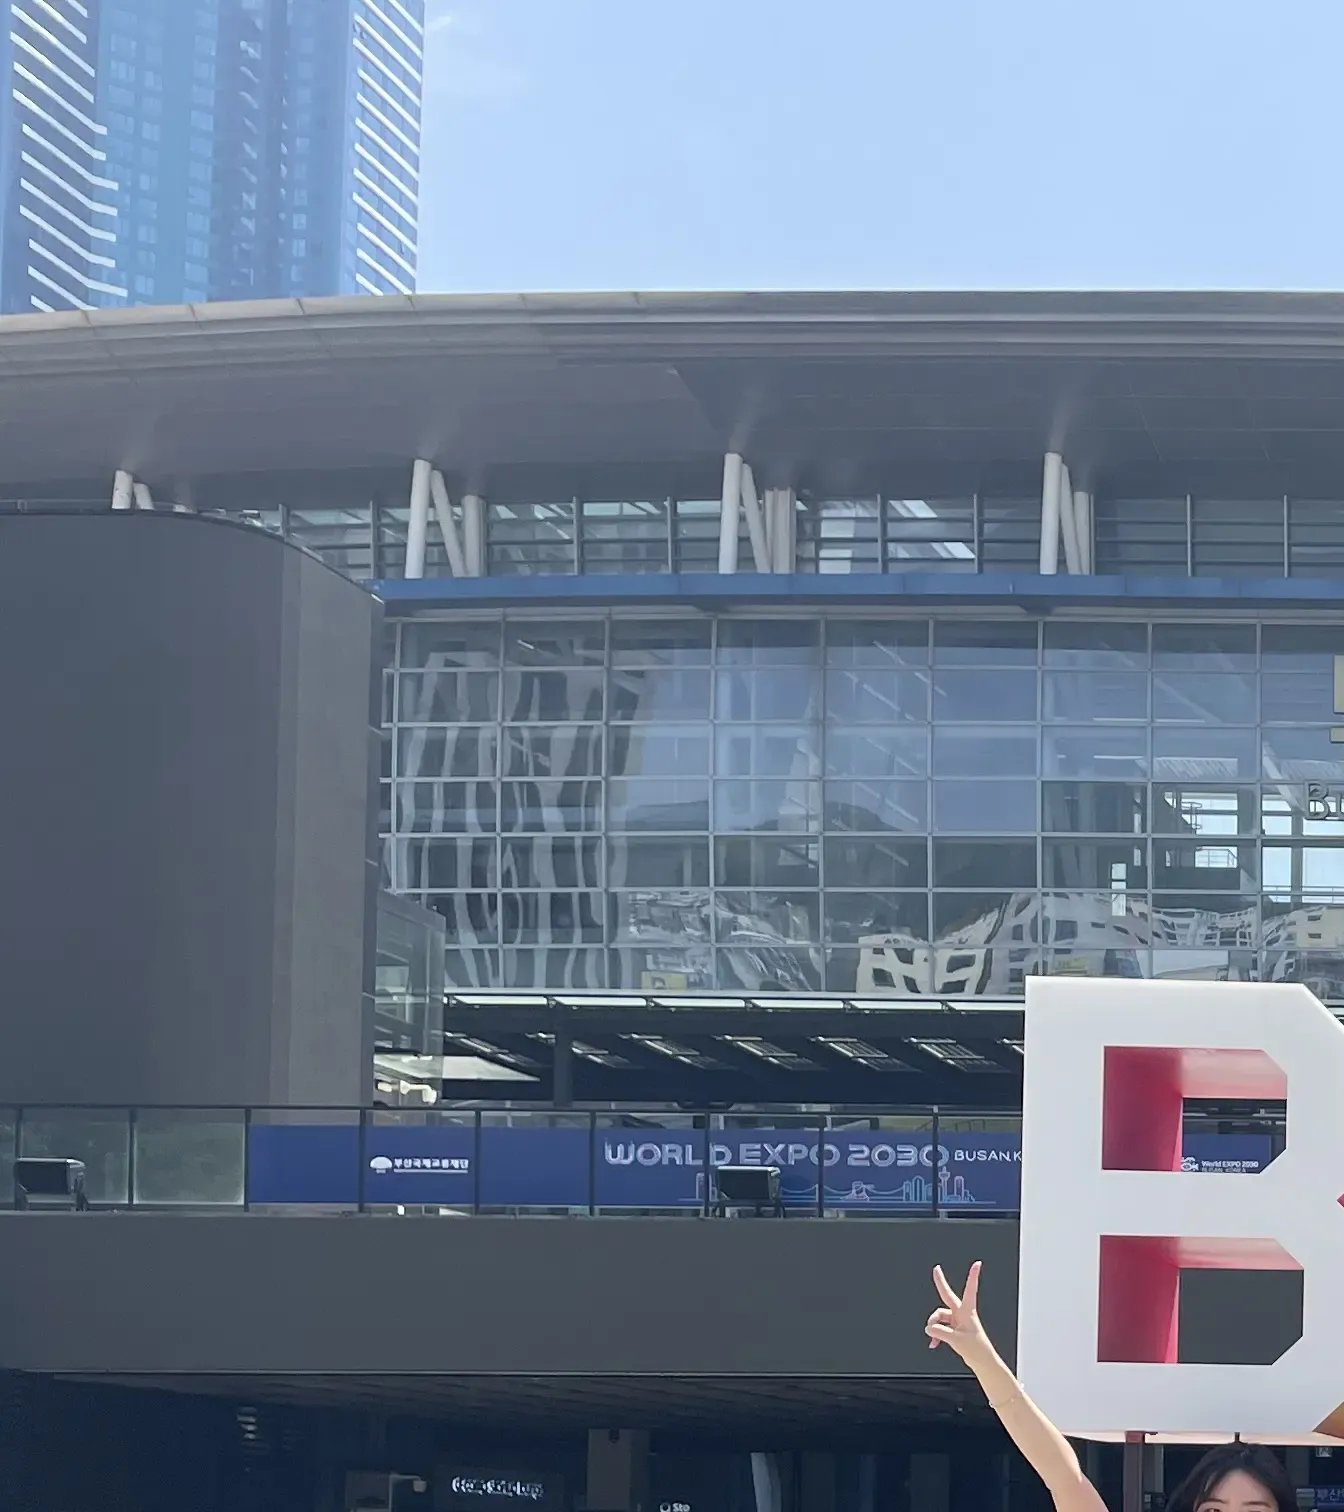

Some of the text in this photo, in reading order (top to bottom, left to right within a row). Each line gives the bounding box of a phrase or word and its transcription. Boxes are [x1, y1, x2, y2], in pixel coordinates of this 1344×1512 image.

[604, 1140, 733, 1167] WORLD
[739, 1142, 841, 1167] EXPO
[847, 1143, 950, 1168] 2030
